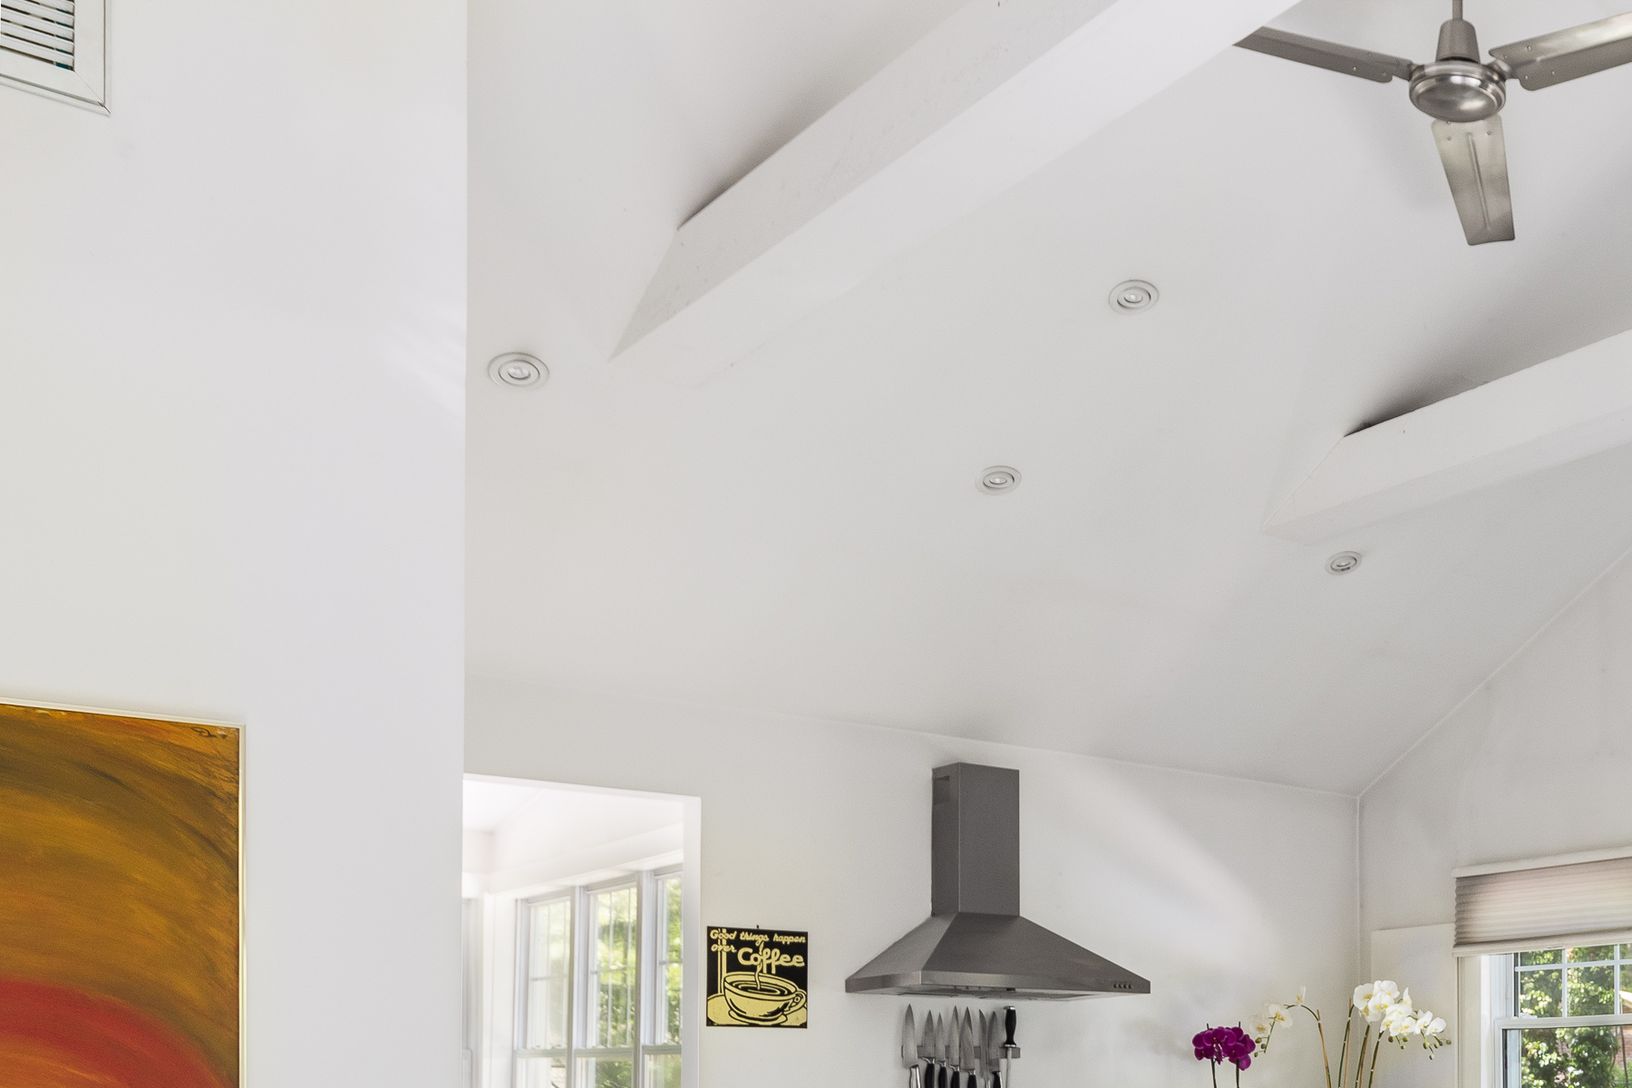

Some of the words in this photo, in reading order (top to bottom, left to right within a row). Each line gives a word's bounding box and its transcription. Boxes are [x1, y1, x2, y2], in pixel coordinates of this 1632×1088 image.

[710, 928, 737, 940] Good
[740, 931, 769, 947] things
[773, 933, 806, 945] happen
[711, 943, 737, 953] over
[737, 947, 805, 974] Coffee
